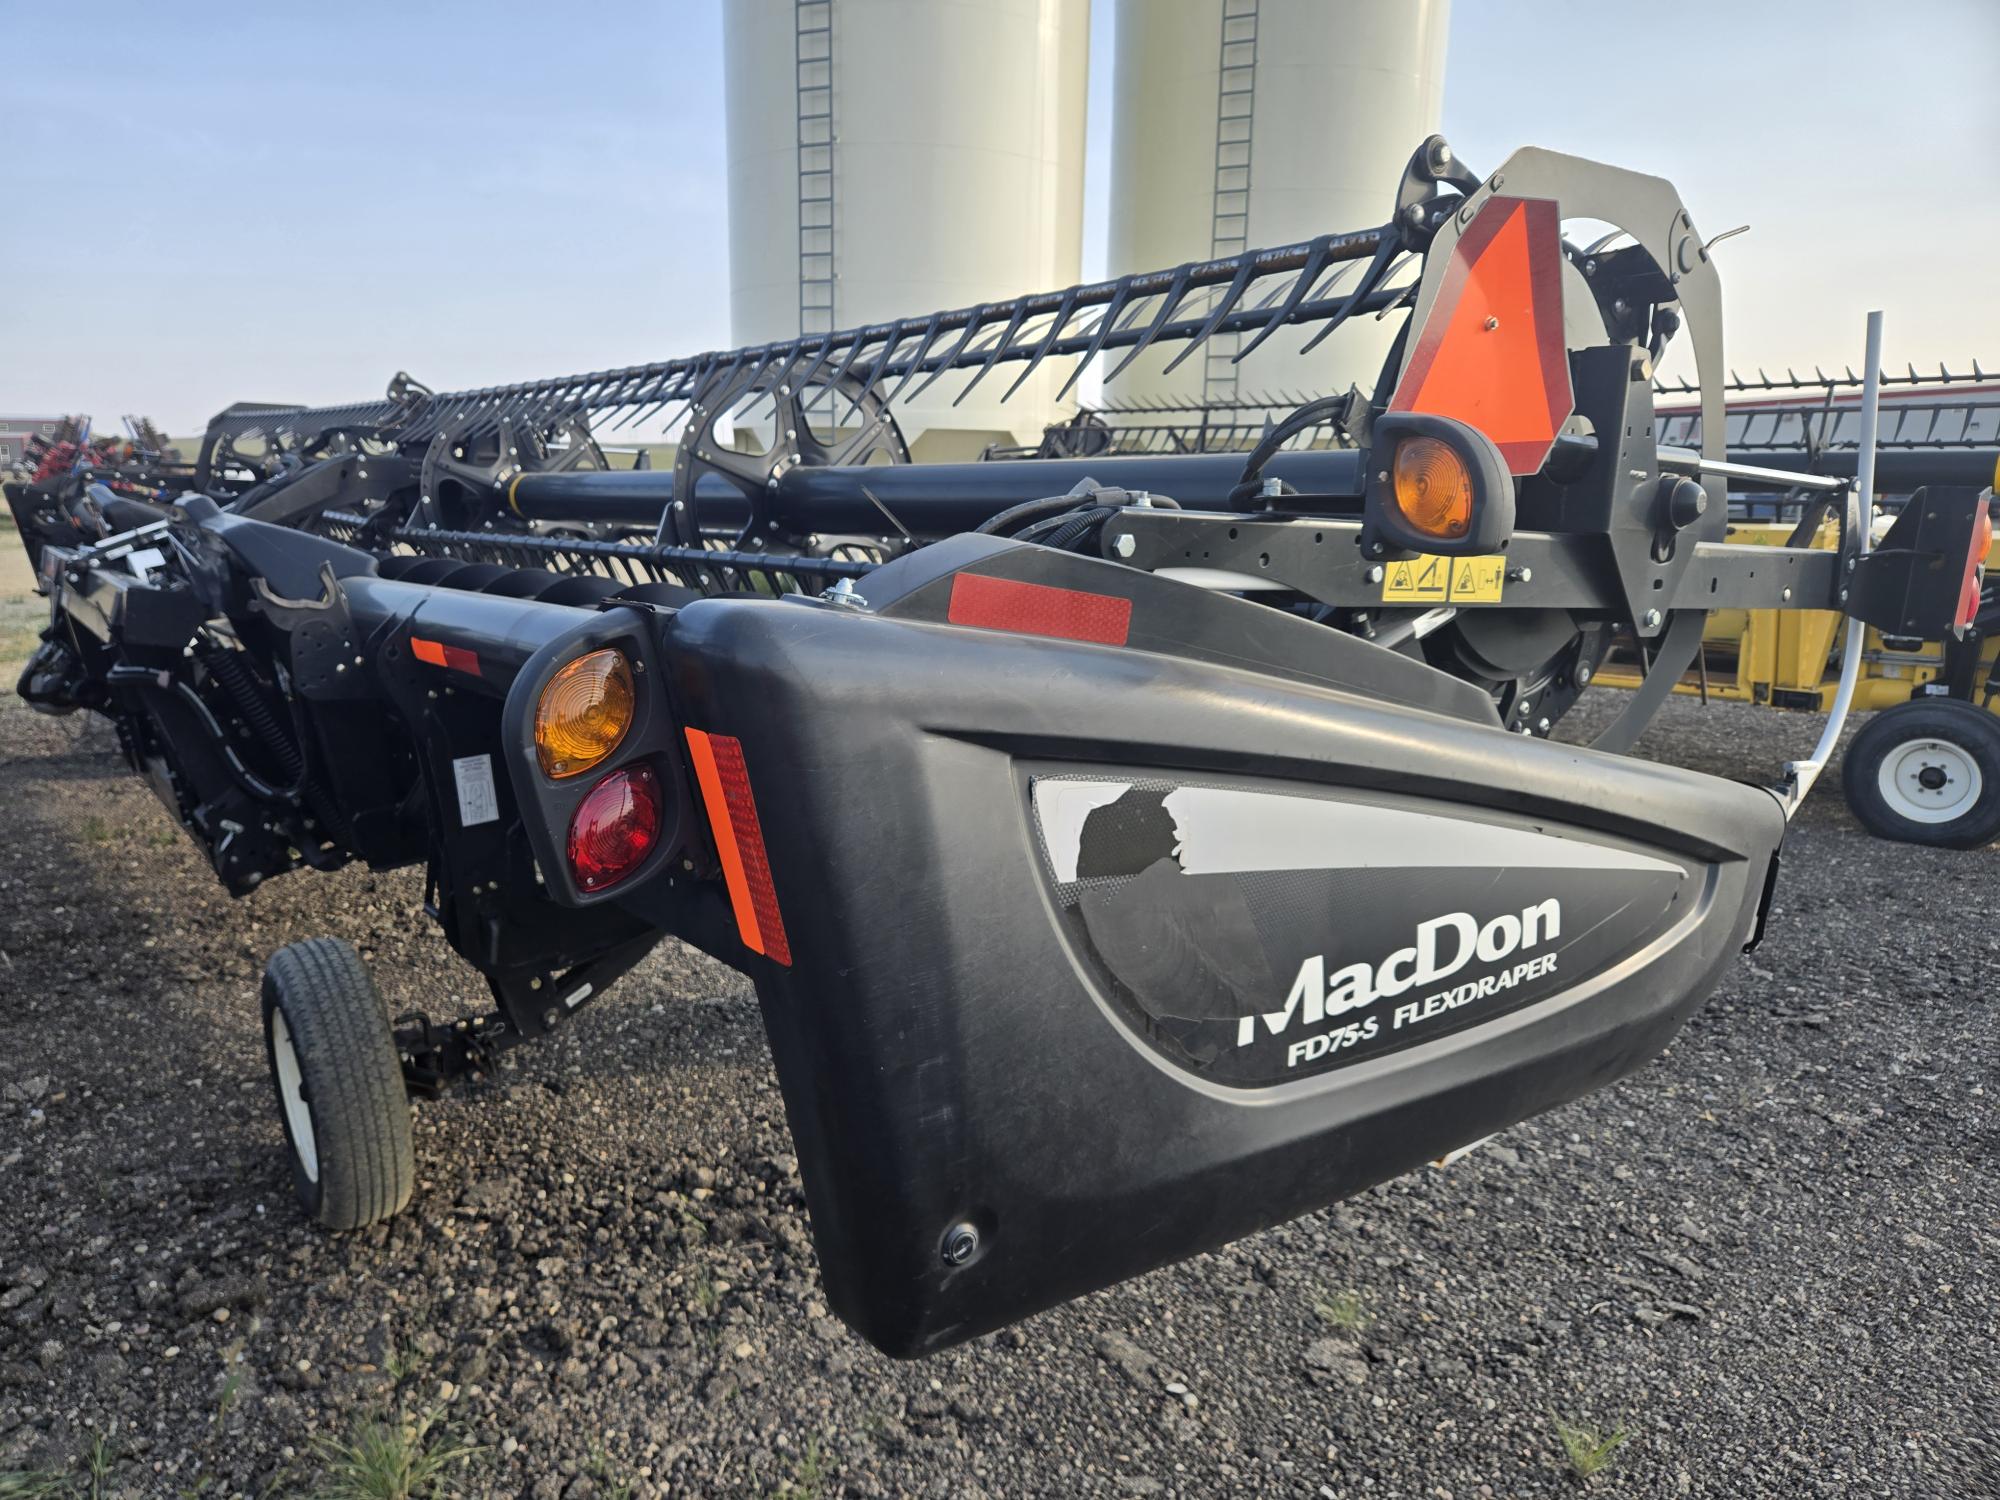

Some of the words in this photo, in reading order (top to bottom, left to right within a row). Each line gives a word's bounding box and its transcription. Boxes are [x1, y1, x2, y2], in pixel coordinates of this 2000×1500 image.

[1237, 898, 1561, 1047] MacDon
[1287, 1016, 1379, 1067] FD75-S
[1393, 952, 1558, 1029] FLEXDRAPER
